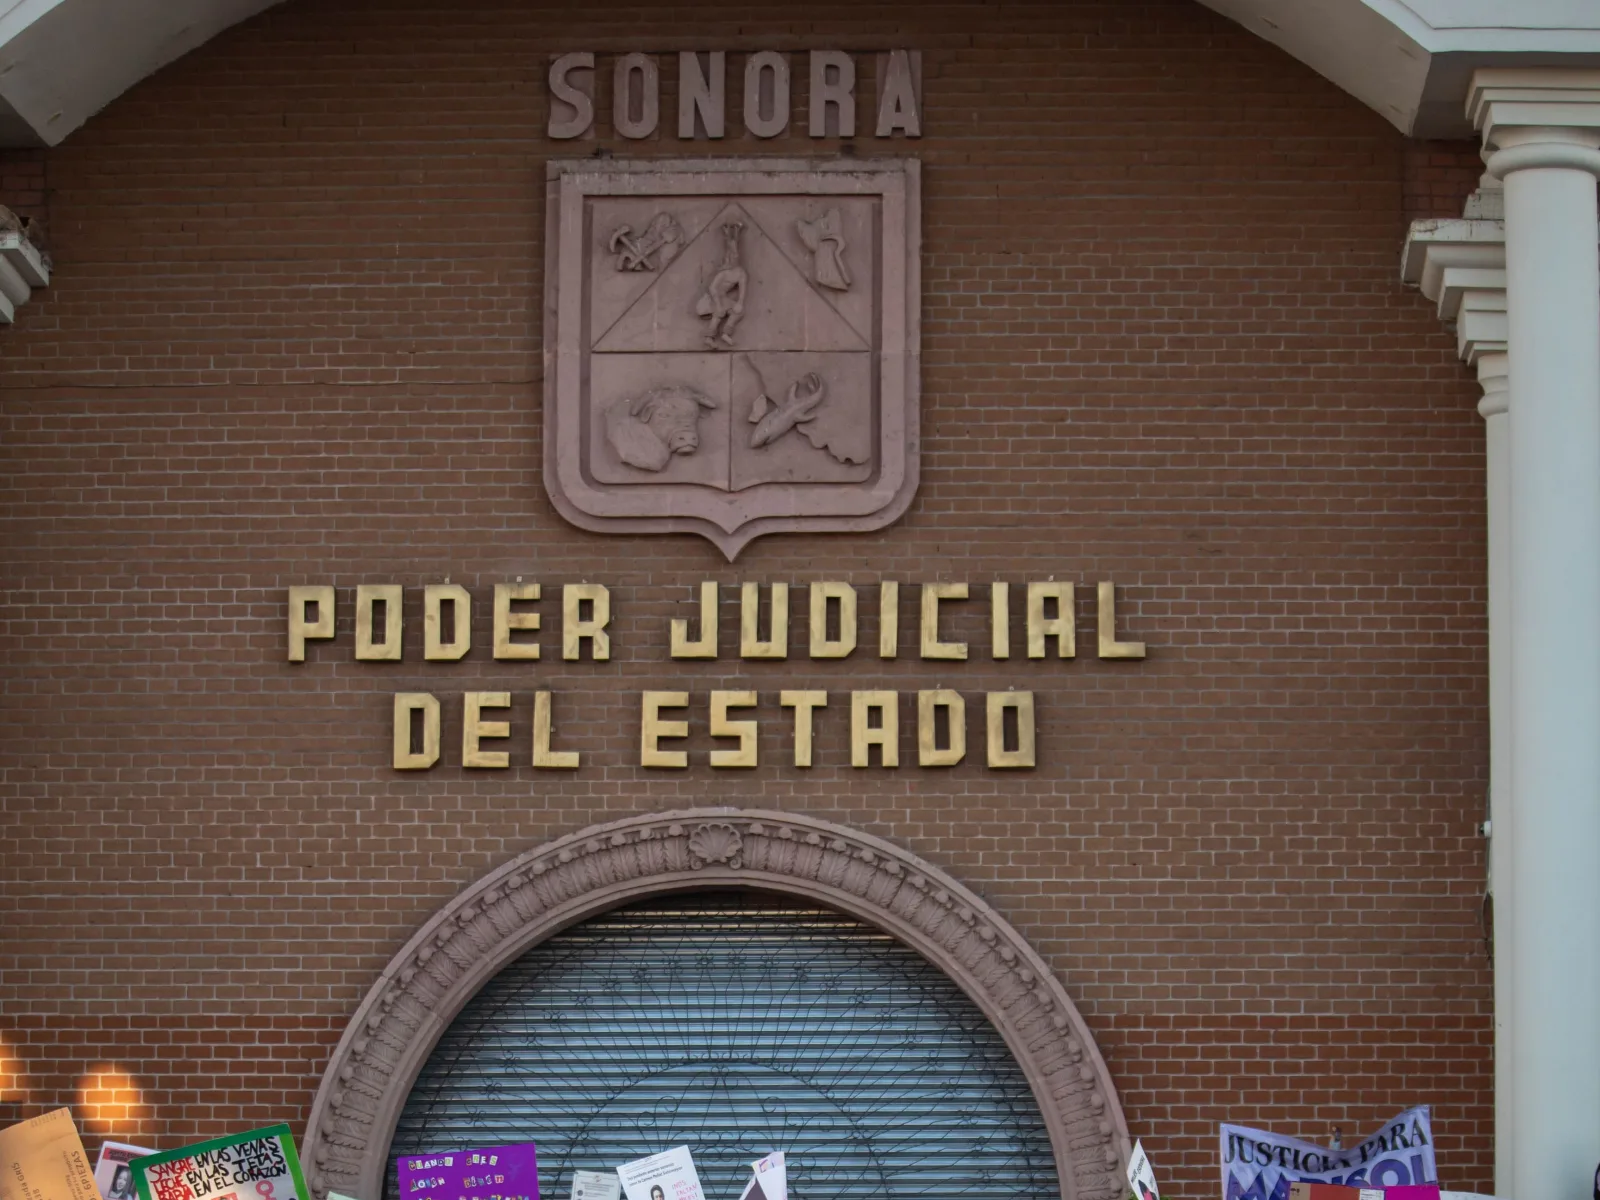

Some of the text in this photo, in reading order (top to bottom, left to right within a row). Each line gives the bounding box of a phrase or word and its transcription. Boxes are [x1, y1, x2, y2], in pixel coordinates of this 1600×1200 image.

[548, 49, 922, 139] SONORA
[288, 581, 1147, 661] PODER JUDICIAL
[393, 689, 1037, 770] DEL ESTADO
[71, 1150, 92, 1191] 6PIEZAS
[149, 1156, 194, 1182] SANGRE
[193, 1152, 209, 1168] EN
[208, 1147, 231, 1164] LAS
[231, 1136, 278, 1158] VENAS
[1225, 1117, 1430, 1174] JUSTICIA PARA
[150, 1150, 285, 1195] LECHE EN LAS TETAS
[194, 1182, 212, 1198] EN
[216, 1177, 234, 1190] EL
